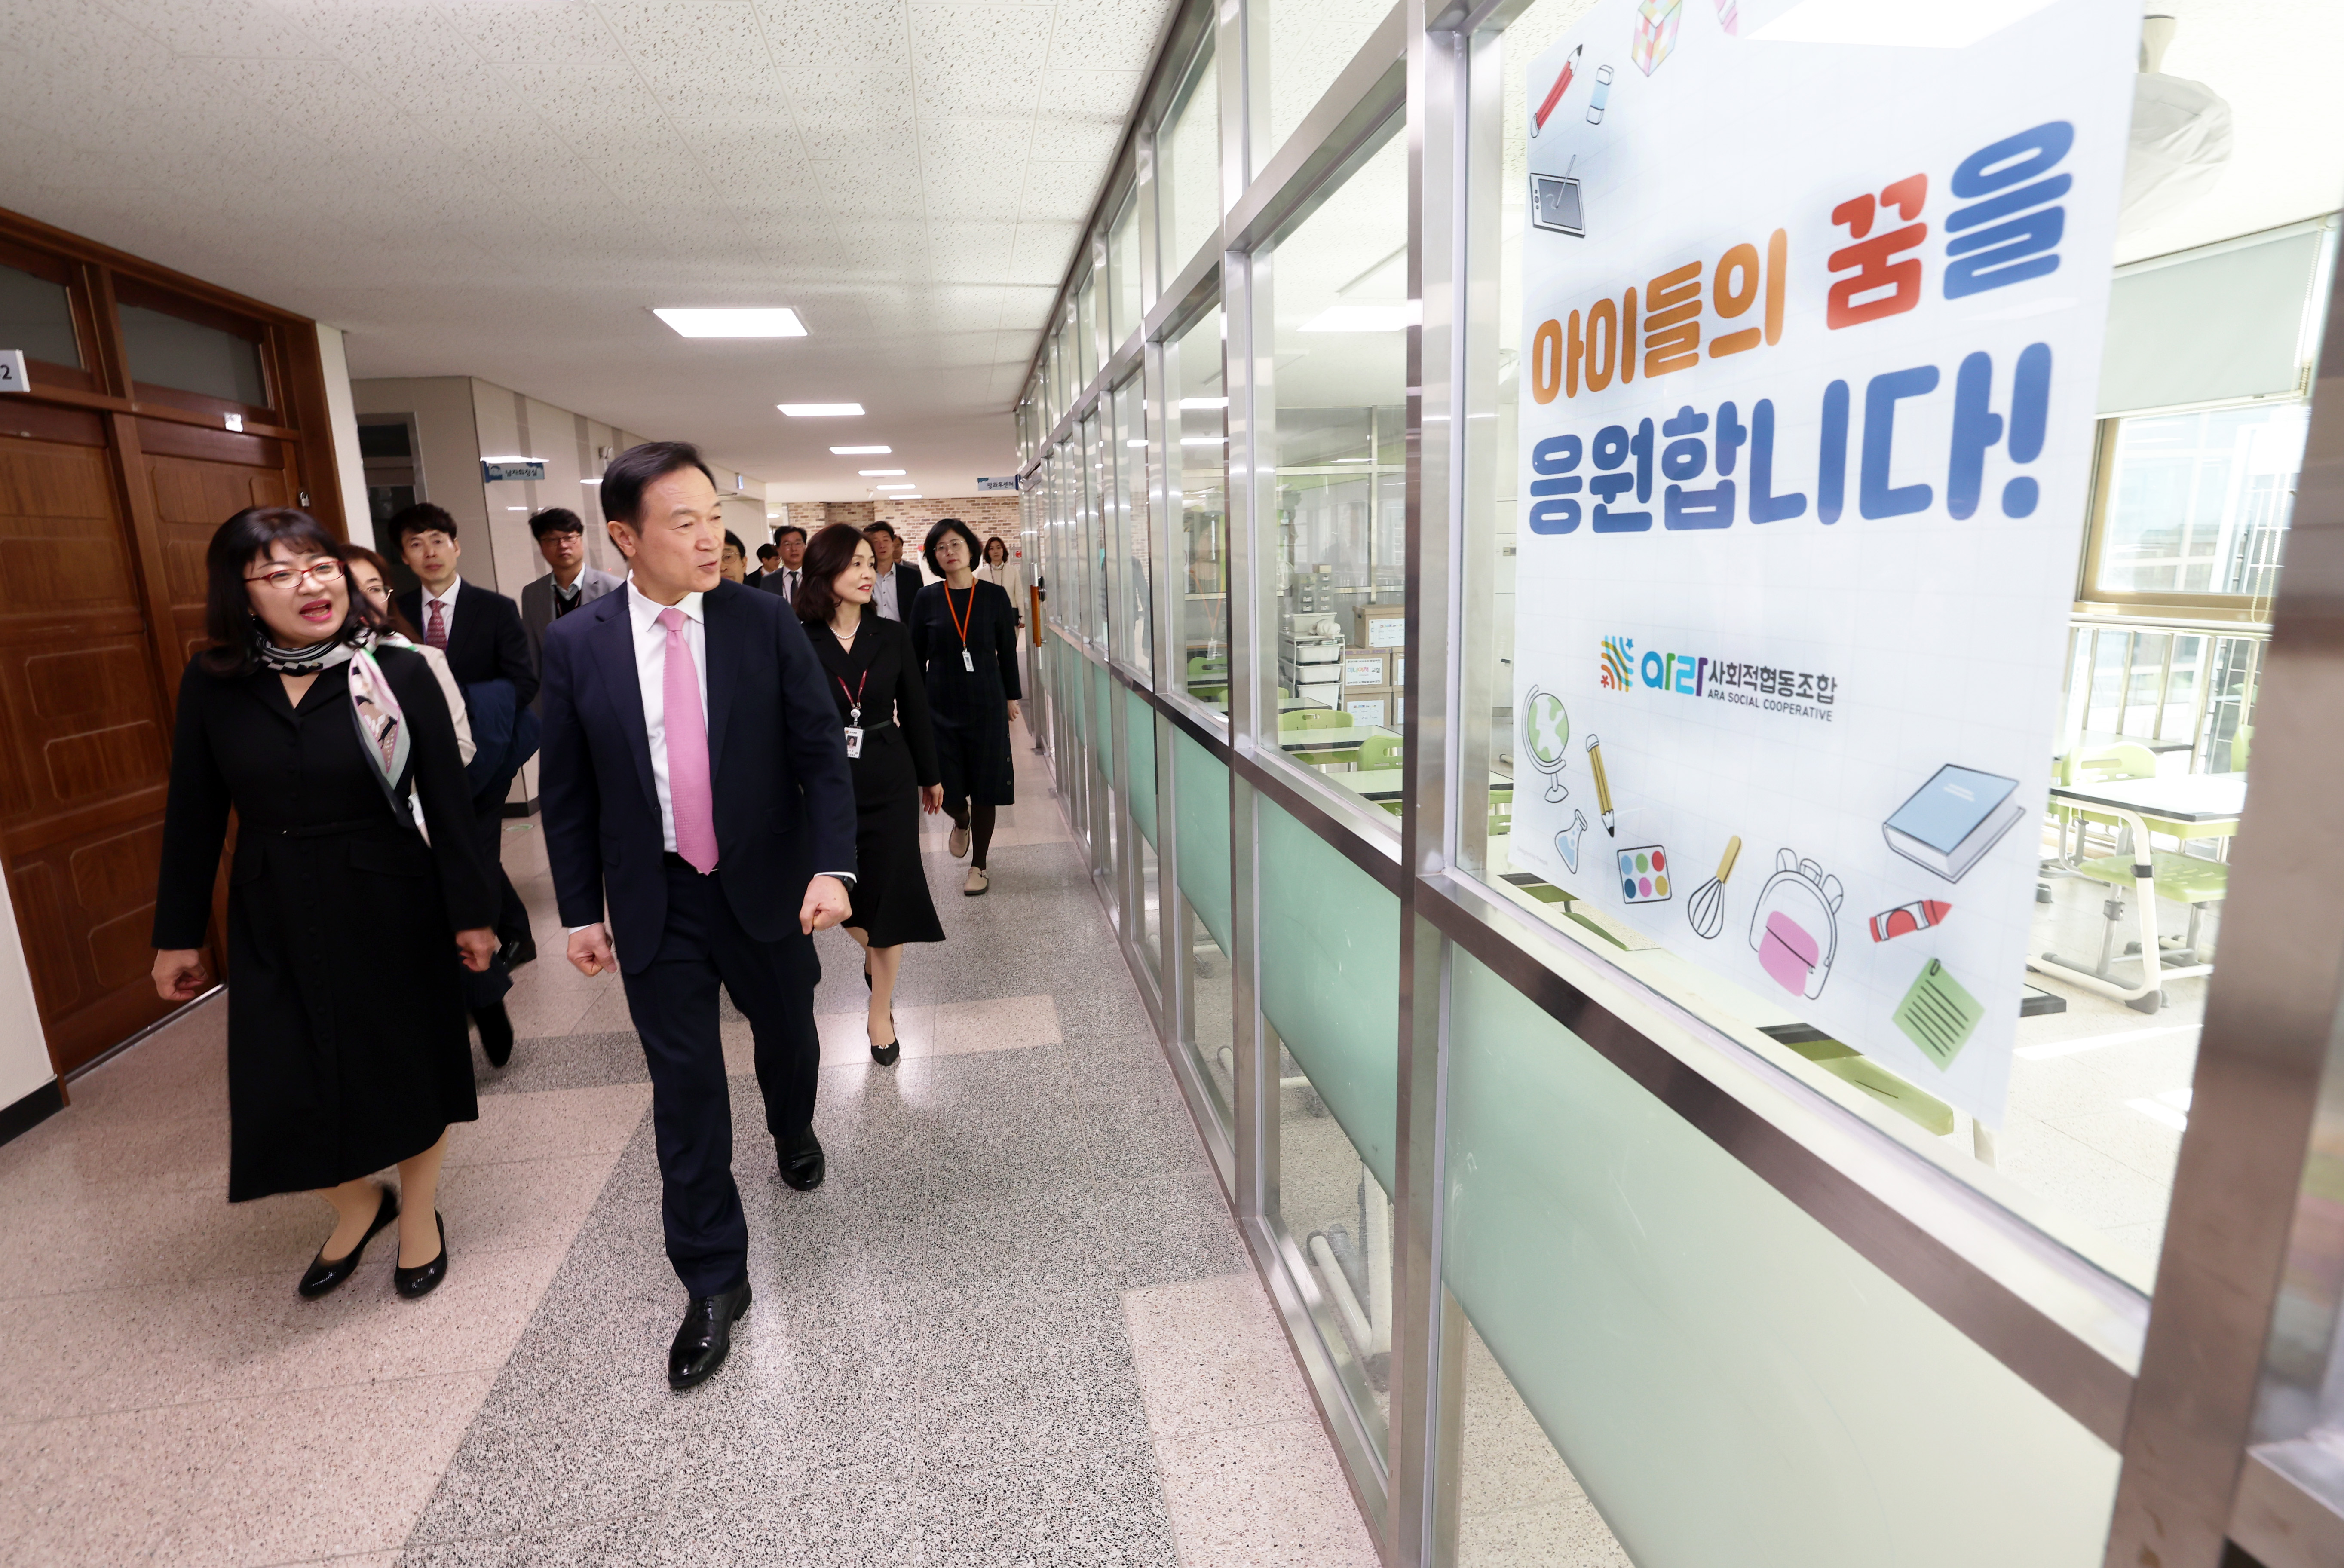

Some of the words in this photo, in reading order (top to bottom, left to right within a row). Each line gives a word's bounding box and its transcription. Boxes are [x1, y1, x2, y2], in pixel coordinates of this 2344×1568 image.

[1532, 229, 1788, 404] 아이들의
[1827, 121, 2074, 330] 꿈을
[1529, 343, 2052, 535] 응원합니다!
[1641, 651, 1708, 696] 아라
[1709, 660, 1838, 705] 사회적협동조합
[1707, 689, 1725, 701] ARA
[1728, 692, 1760, 708] SOCIAL
[1763, 699, 1832, 722] COOPERATIVE
